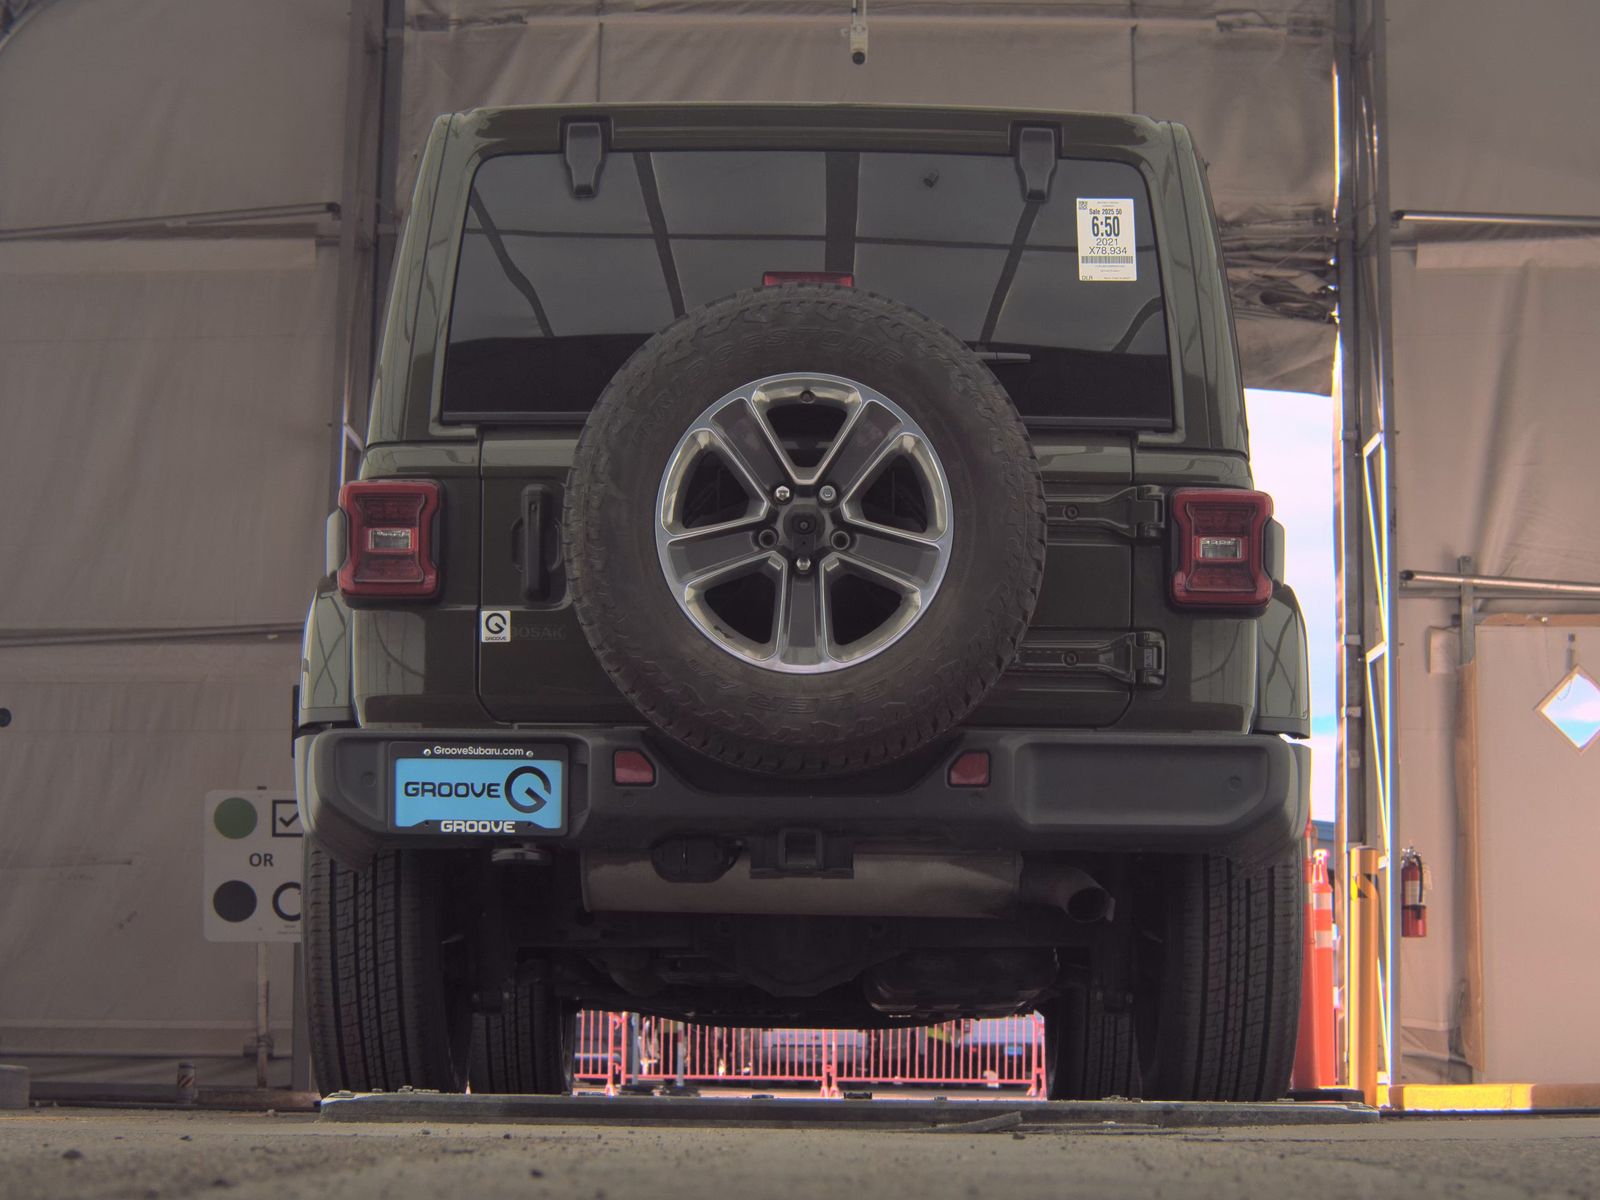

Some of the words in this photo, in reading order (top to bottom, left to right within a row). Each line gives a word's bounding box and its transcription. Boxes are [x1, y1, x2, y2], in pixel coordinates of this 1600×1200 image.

[1091, 216, 1120, 237] 6:50
[1096, 237, 1118, 246] 2021
[1088, 246, 1127, 256] X78,934
[433, 745, 524, 756] GrooveSubaru.com
[404, 781, 501, 798] GROOVE
[440, 820, 516, 833] GROOVE
[249, 853, 274, 867] OR
